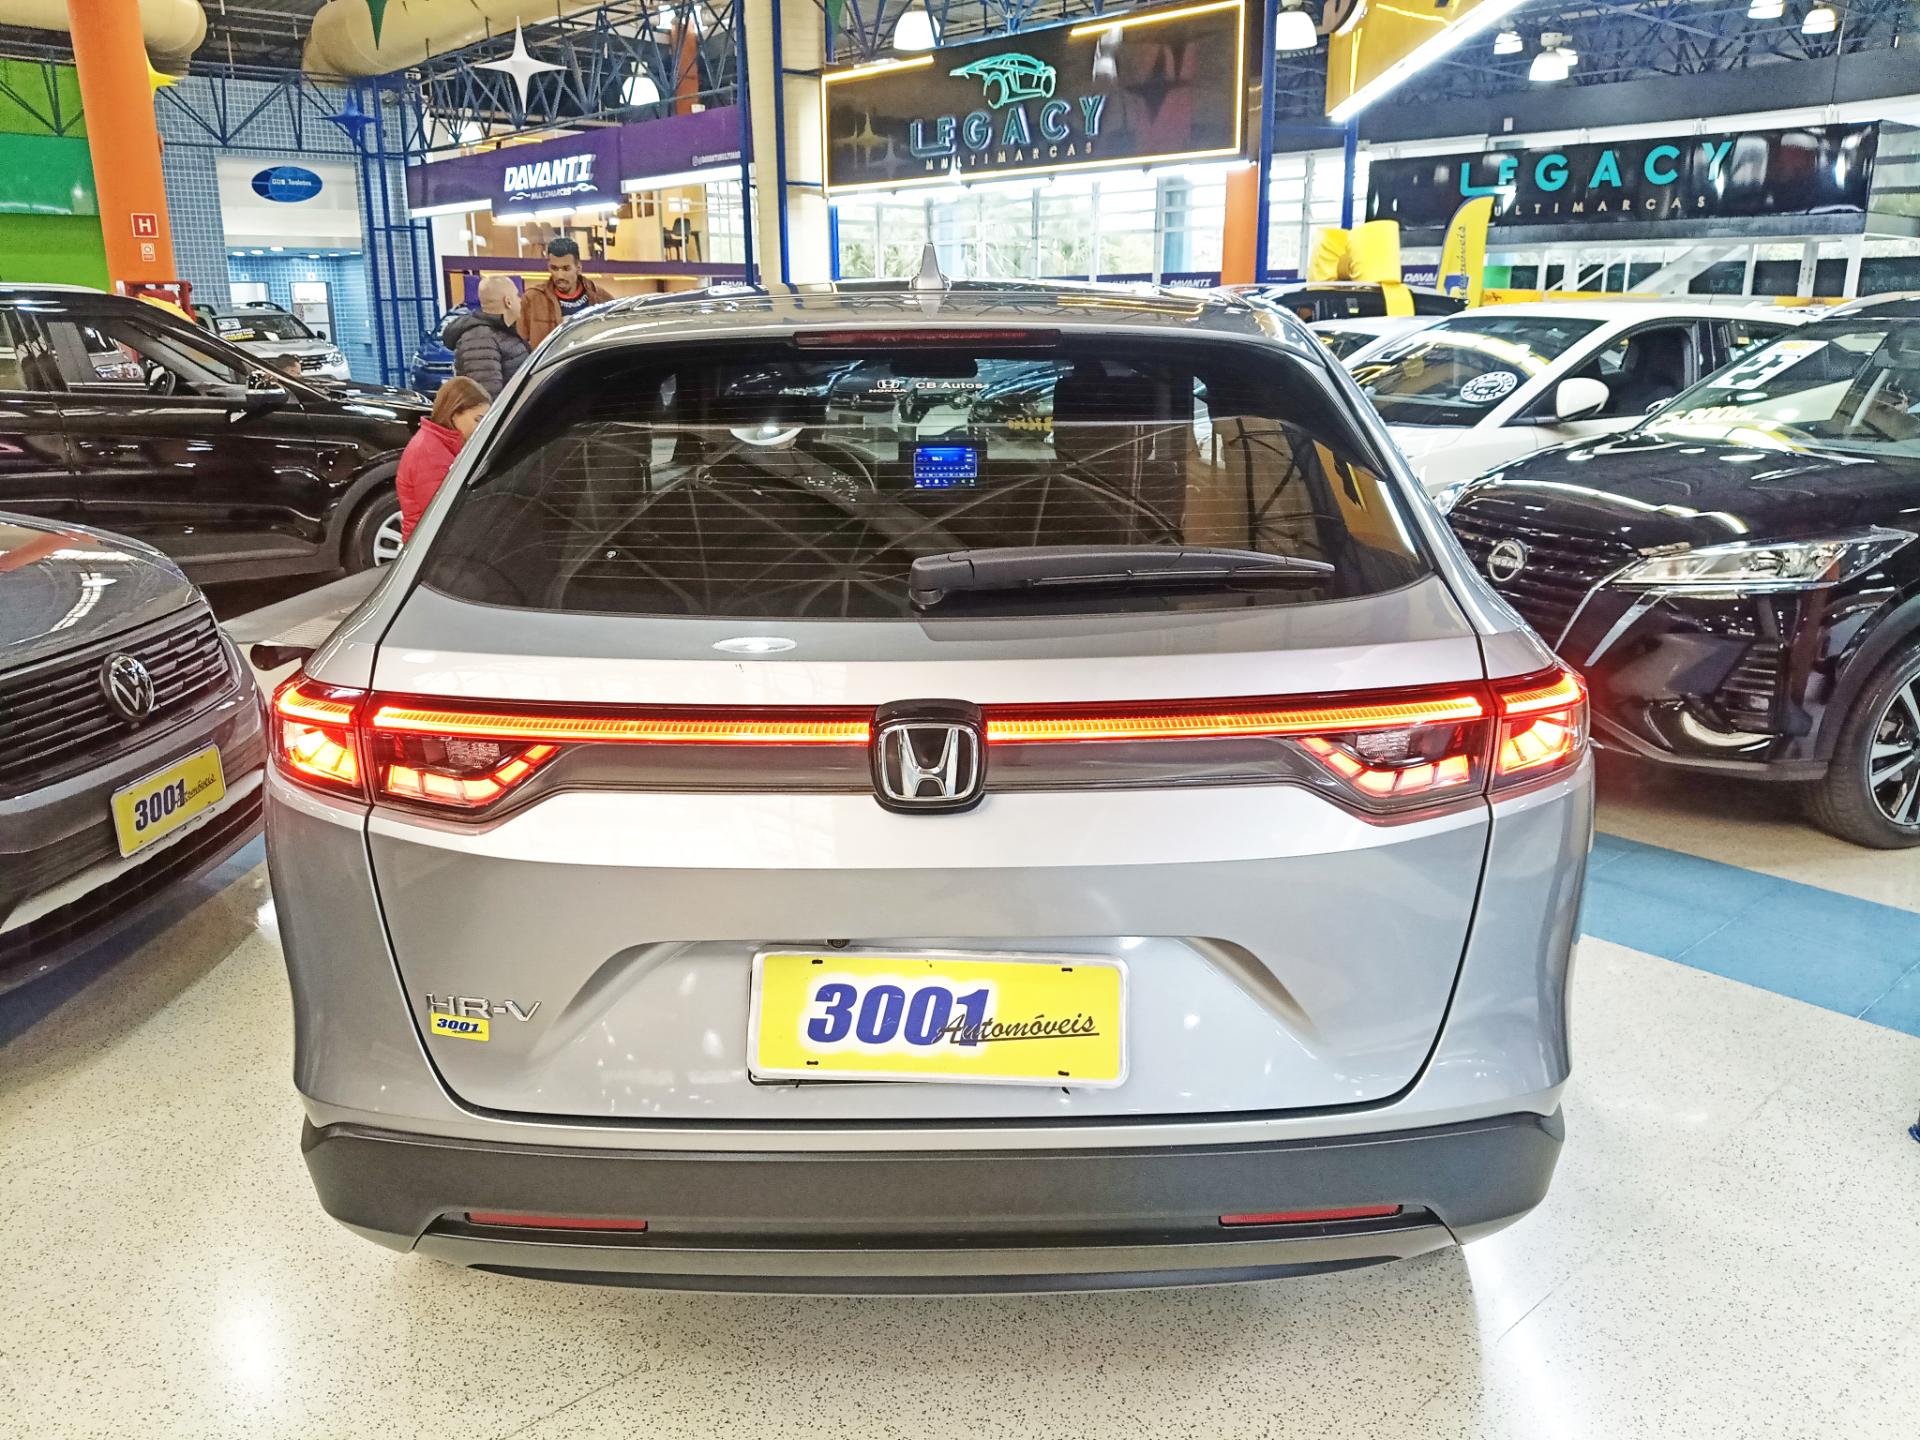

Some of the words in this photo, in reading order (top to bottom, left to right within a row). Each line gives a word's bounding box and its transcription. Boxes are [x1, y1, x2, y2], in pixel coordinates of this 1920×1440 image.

[909, 95, 1107, 158] LEGACY
[503, 153, 597, 192] DAVANTI
[925, 141, 1094, 171] MULTIMARCAS
[1459, 142, 1734, 197] LEGACY
[1494, 195, 1706, 217] ULTIMARCAS
[915, 381, 937, 389] CB
[940, 381, 983, 389] Autos
[134, 778, 186, 832] 3001
[426, 993, 543, 1022] HR-V
[807, 983, 990, 1047] 3001
[930, 1014, 1100, 1045] Automóveis
[436, 1018, 480, 1033] 3001
